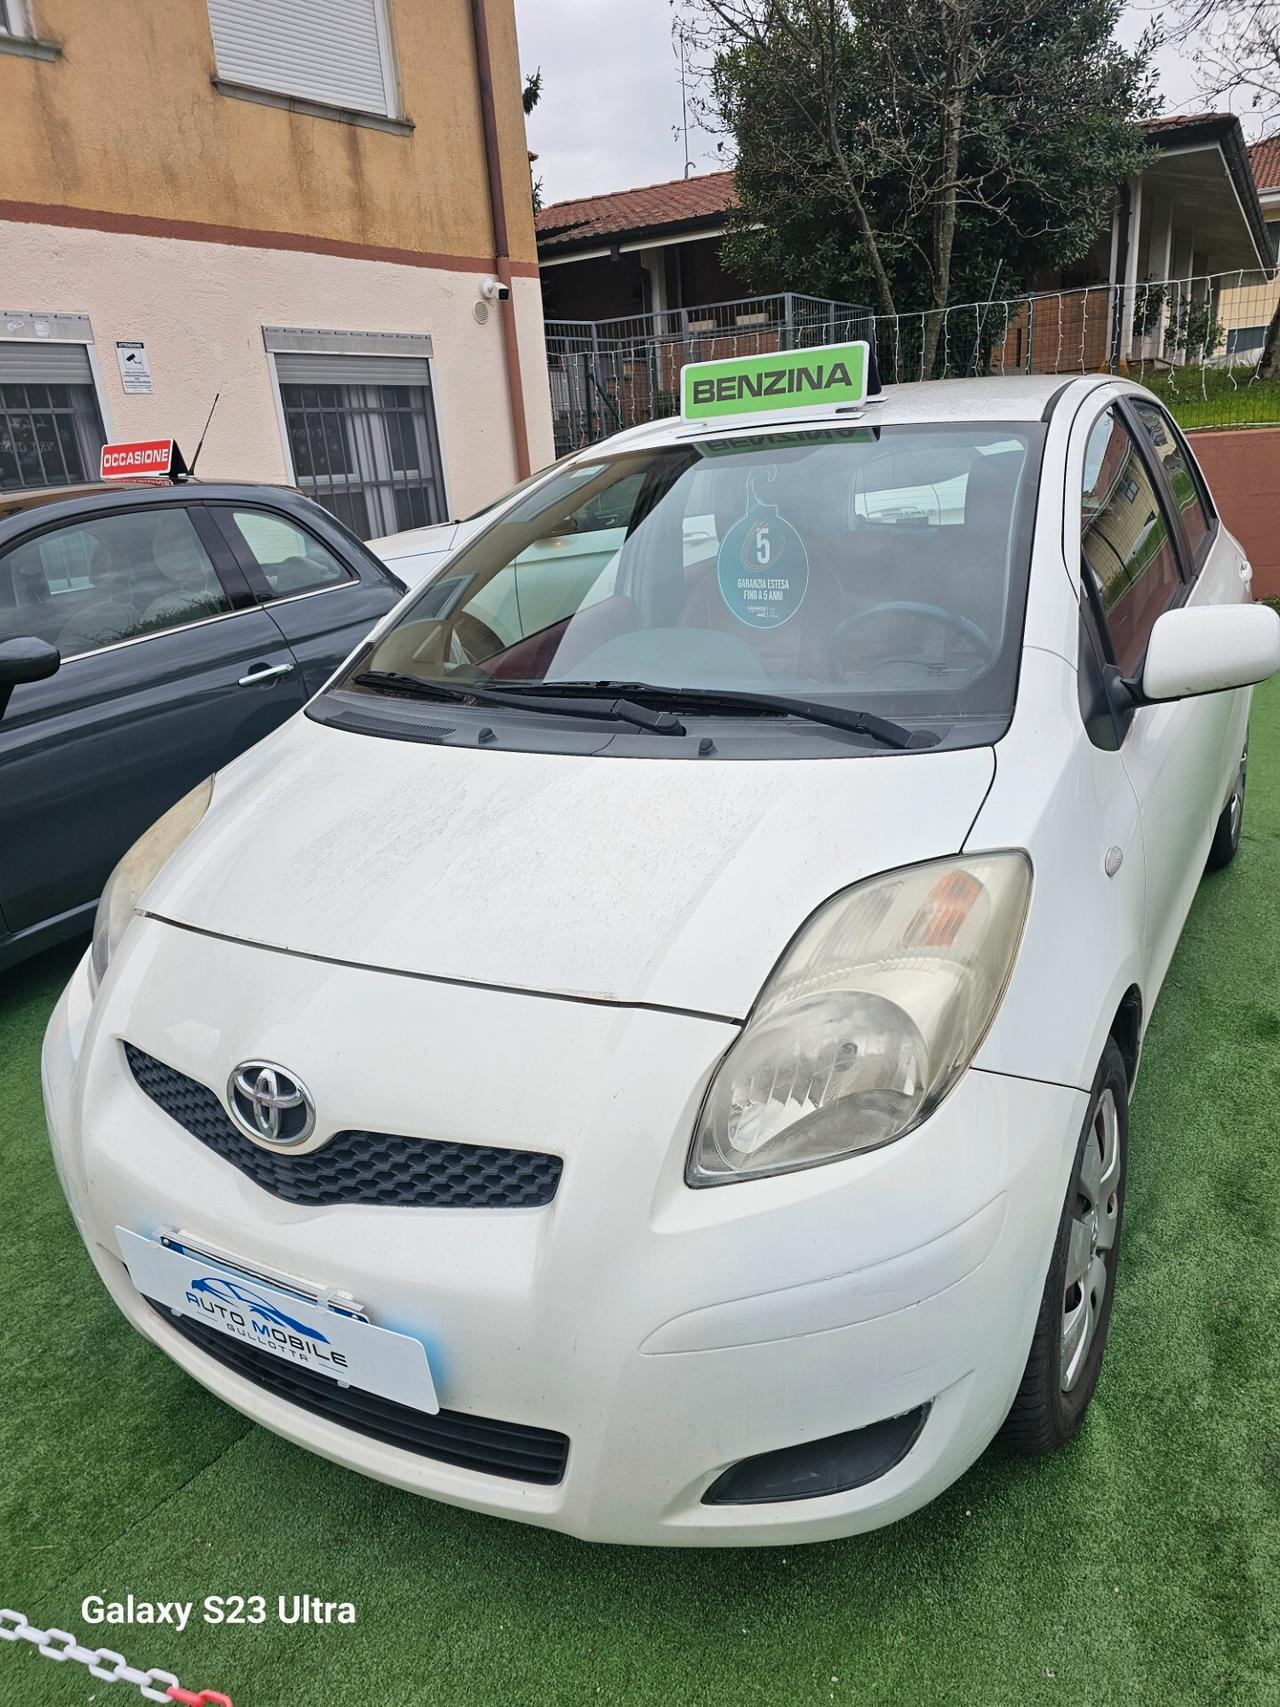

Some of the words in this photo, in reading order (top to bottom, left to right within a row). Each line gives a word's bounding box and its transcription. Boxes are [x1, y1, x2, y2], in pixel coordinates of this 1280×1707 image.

[693, 362, 853, 404] BENZINA
[103, 448, 169, 467] OCCASIONE
[756, 527, 771, 564] 5
[737, 578, 767, 589] GARANZIA
[767, 579, 790, 590] ESTESA
[743, 590, 758, 600] FINO
[758, 590, 763, 600] A
[763, 591, 768, 600] 5
[768, 591, 783, 601] ANNI
[186, 1291, 246, 1327] AUTO
[251, 1320, 348, 1368] MOBILE
[226, 1323, 309, 1362] GULLOTTA
